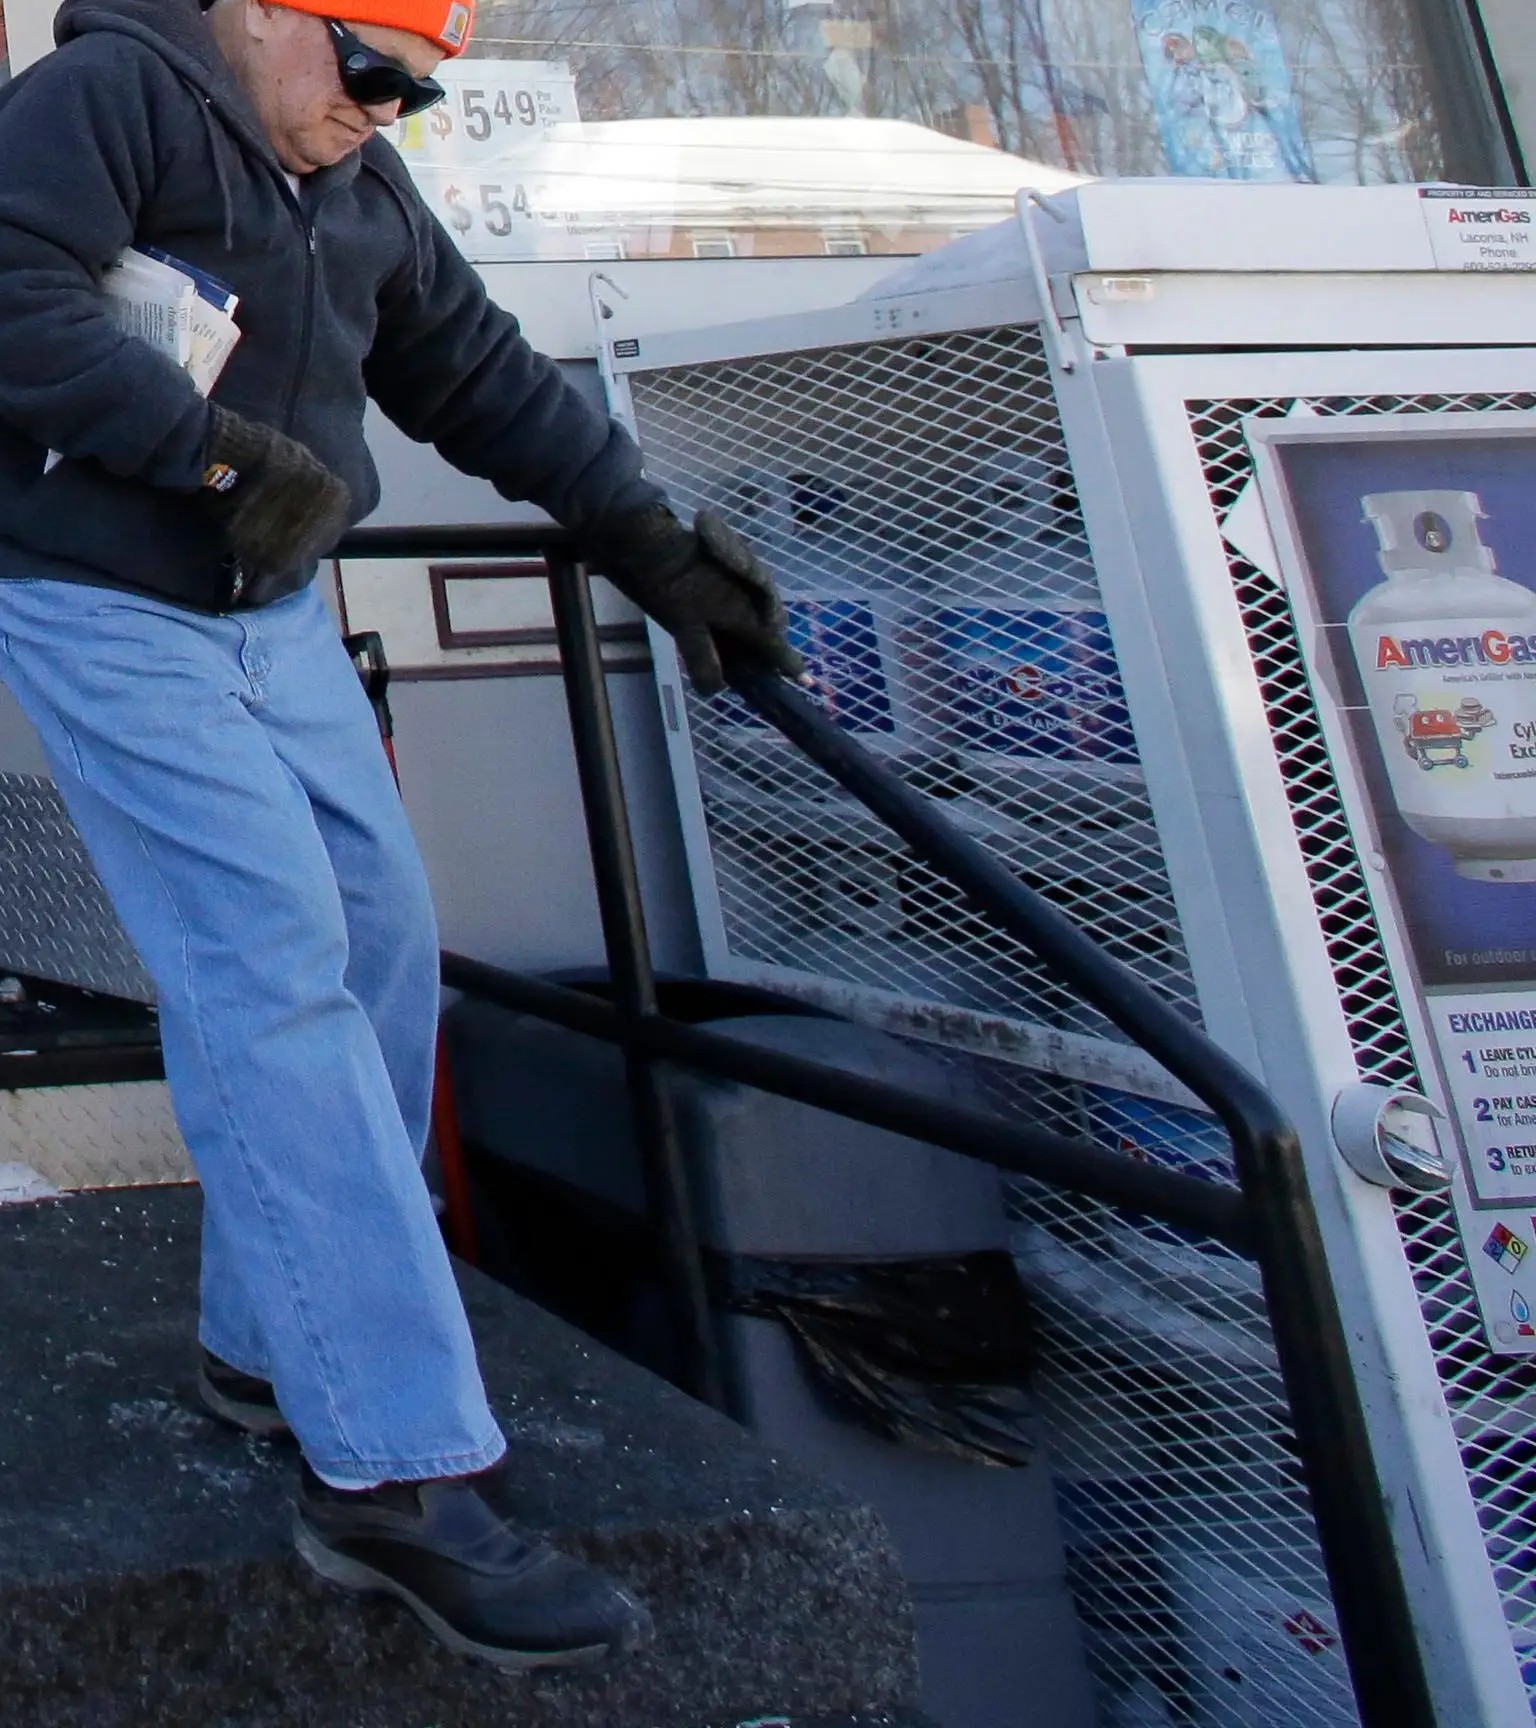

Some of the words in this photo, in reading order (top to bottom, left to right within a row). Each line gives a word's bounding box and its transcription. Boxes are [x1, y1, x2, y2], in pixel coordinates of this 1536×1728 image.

[1448, 208, 1531, 224] AmeriGas
[1510, 232, 1529, 244] NH
[1375, 630, 1536, 671] AmeriGa
[1444, 949, 1469, 967] For
[1471, 949, 1526, 965] outdoor
[1461, 1049, 1478, 1074] 1
[1479, 1048, 1515, 1062] LEAVE
[1484, 1063, 1499, 1078] Do
[1502, 1062, 1519, 1077] not
[1473, 1097, 1494, 1122] 2
[1492, 1097, 1514, 1110] PAY
[1497, 1113, 1512, 1127] for
[1485, 1147, 1506, 1172] 3
[1510, 1161, 1523, 1176] to
[1511, 1240, 1521, 1255] 0
